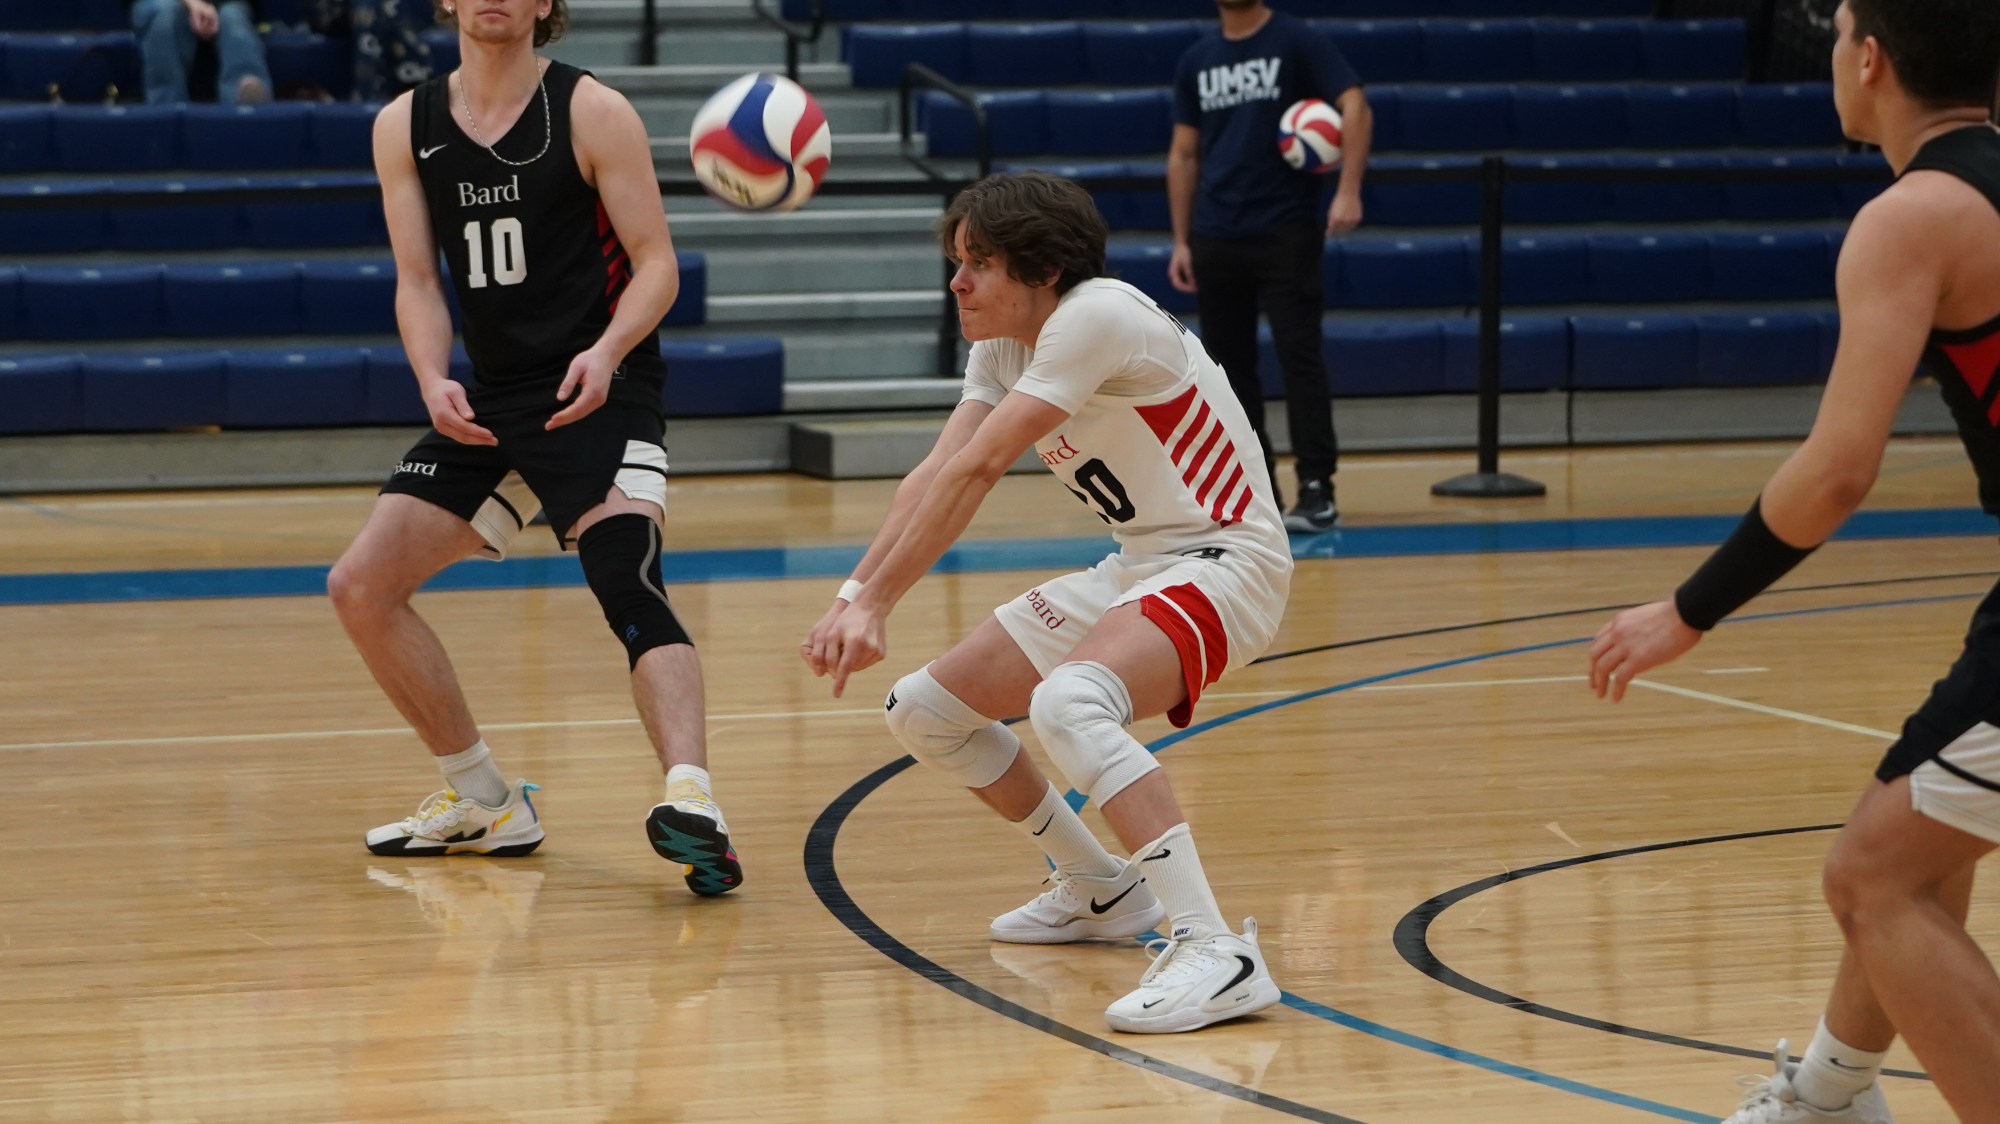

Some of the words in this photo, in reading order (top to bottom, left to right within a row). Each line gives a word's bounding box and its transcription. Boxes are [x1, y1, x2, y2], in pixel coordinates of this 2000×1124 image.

[1198, 57, 1282, 99] UMSV
[458, 174, 521, 207] Bard
[464, 217, 528, 289] 10
[1037, 434, 1081, 466] ard
[1062, 457, 1136, 525] 0
[1026, 588, 1066, 631] Bard
